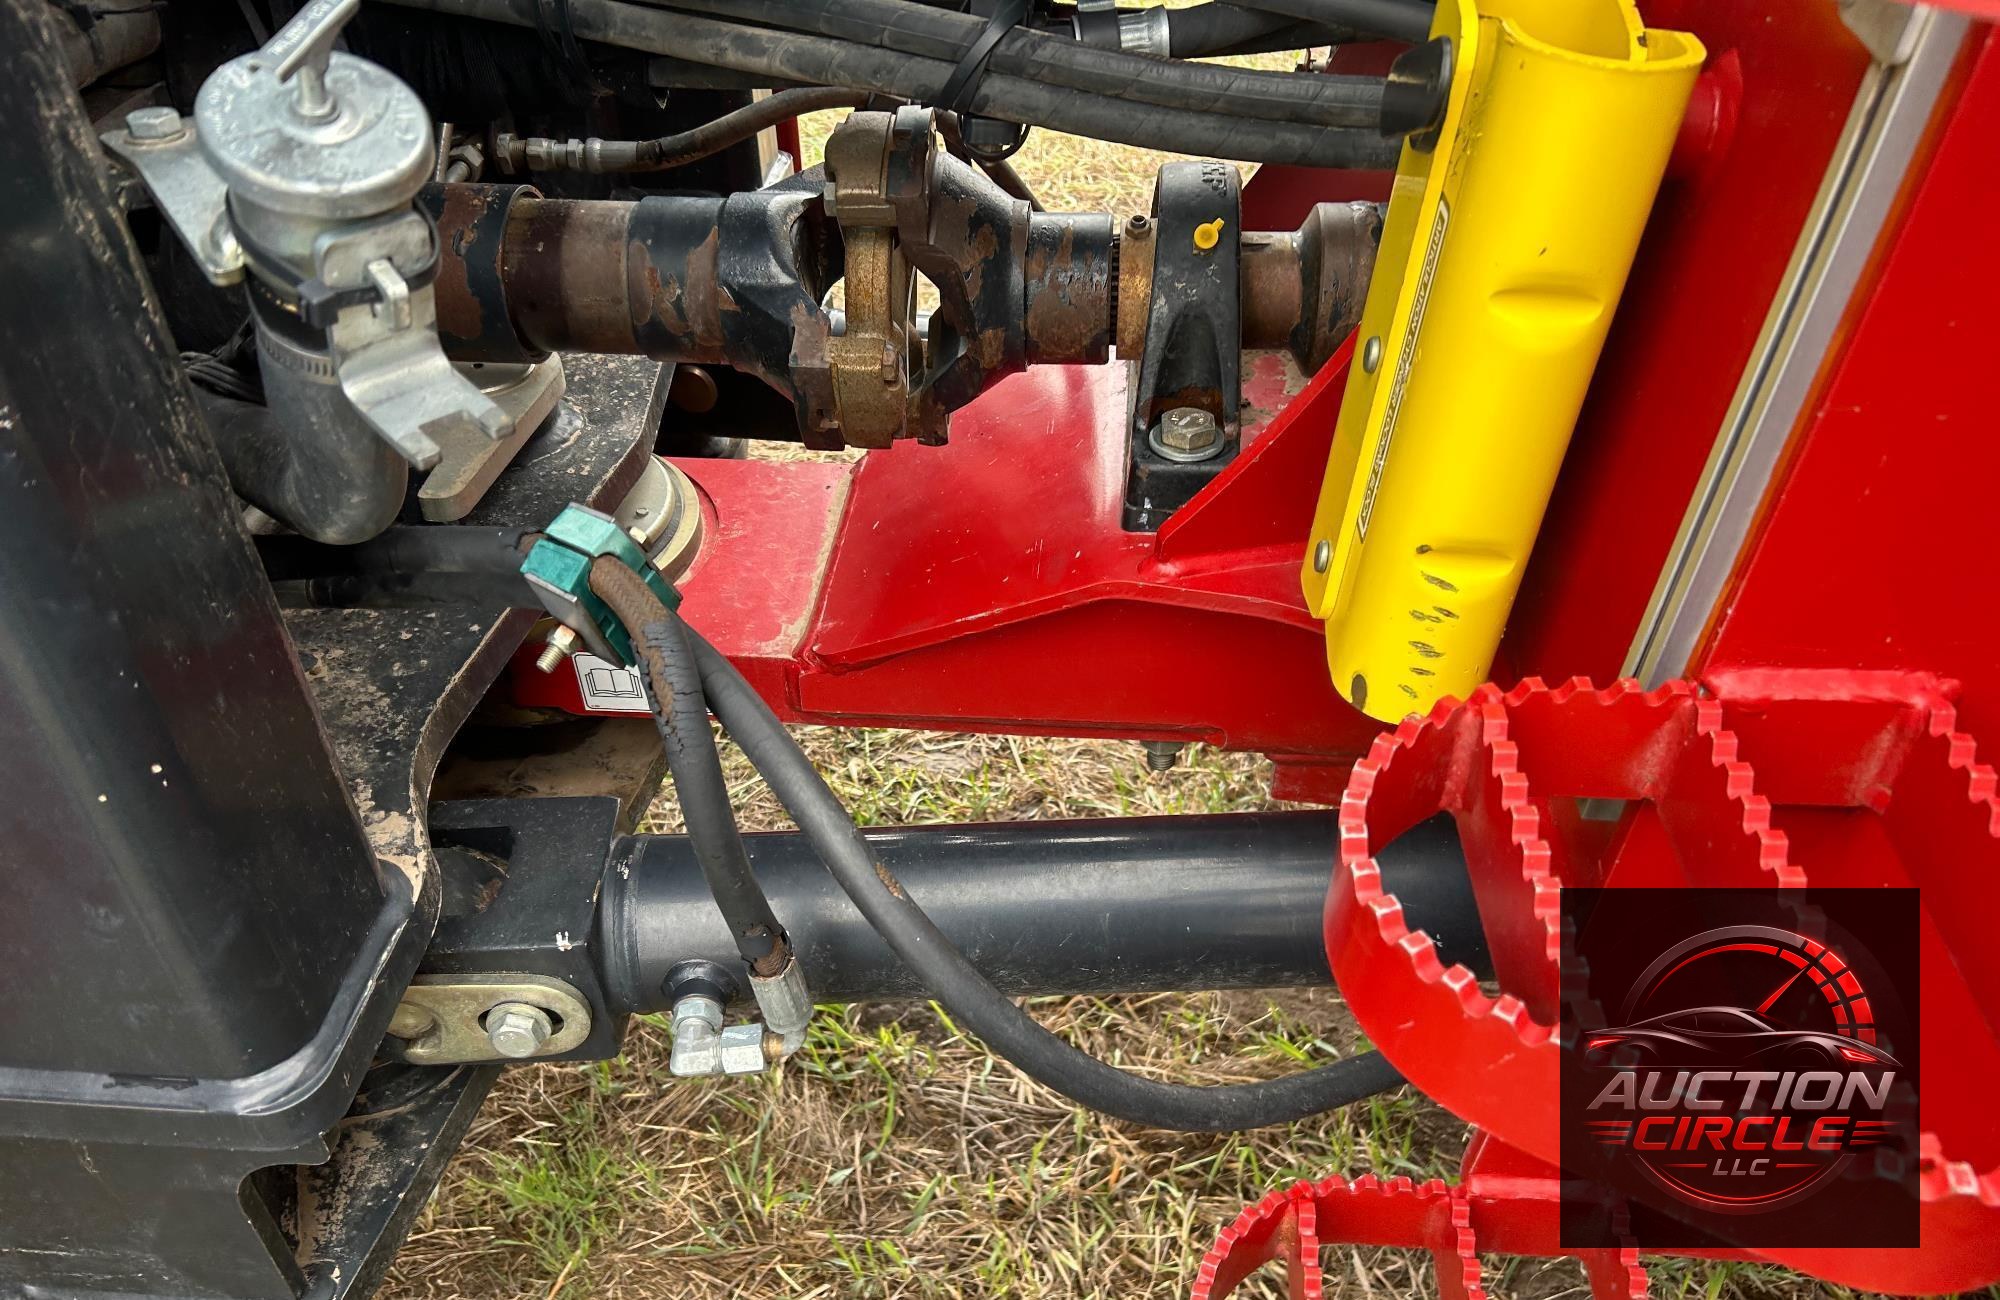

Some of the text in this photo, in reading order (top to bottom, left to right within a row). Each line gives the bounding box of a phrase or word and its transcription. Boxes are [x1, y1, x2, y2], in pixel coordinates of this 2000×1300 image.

[1412, 218, 1442, 332] ARTICULATION
[1374, 409, 1393, 473] LOCKING
[1362, 473, 1376, 520] BLOCK
